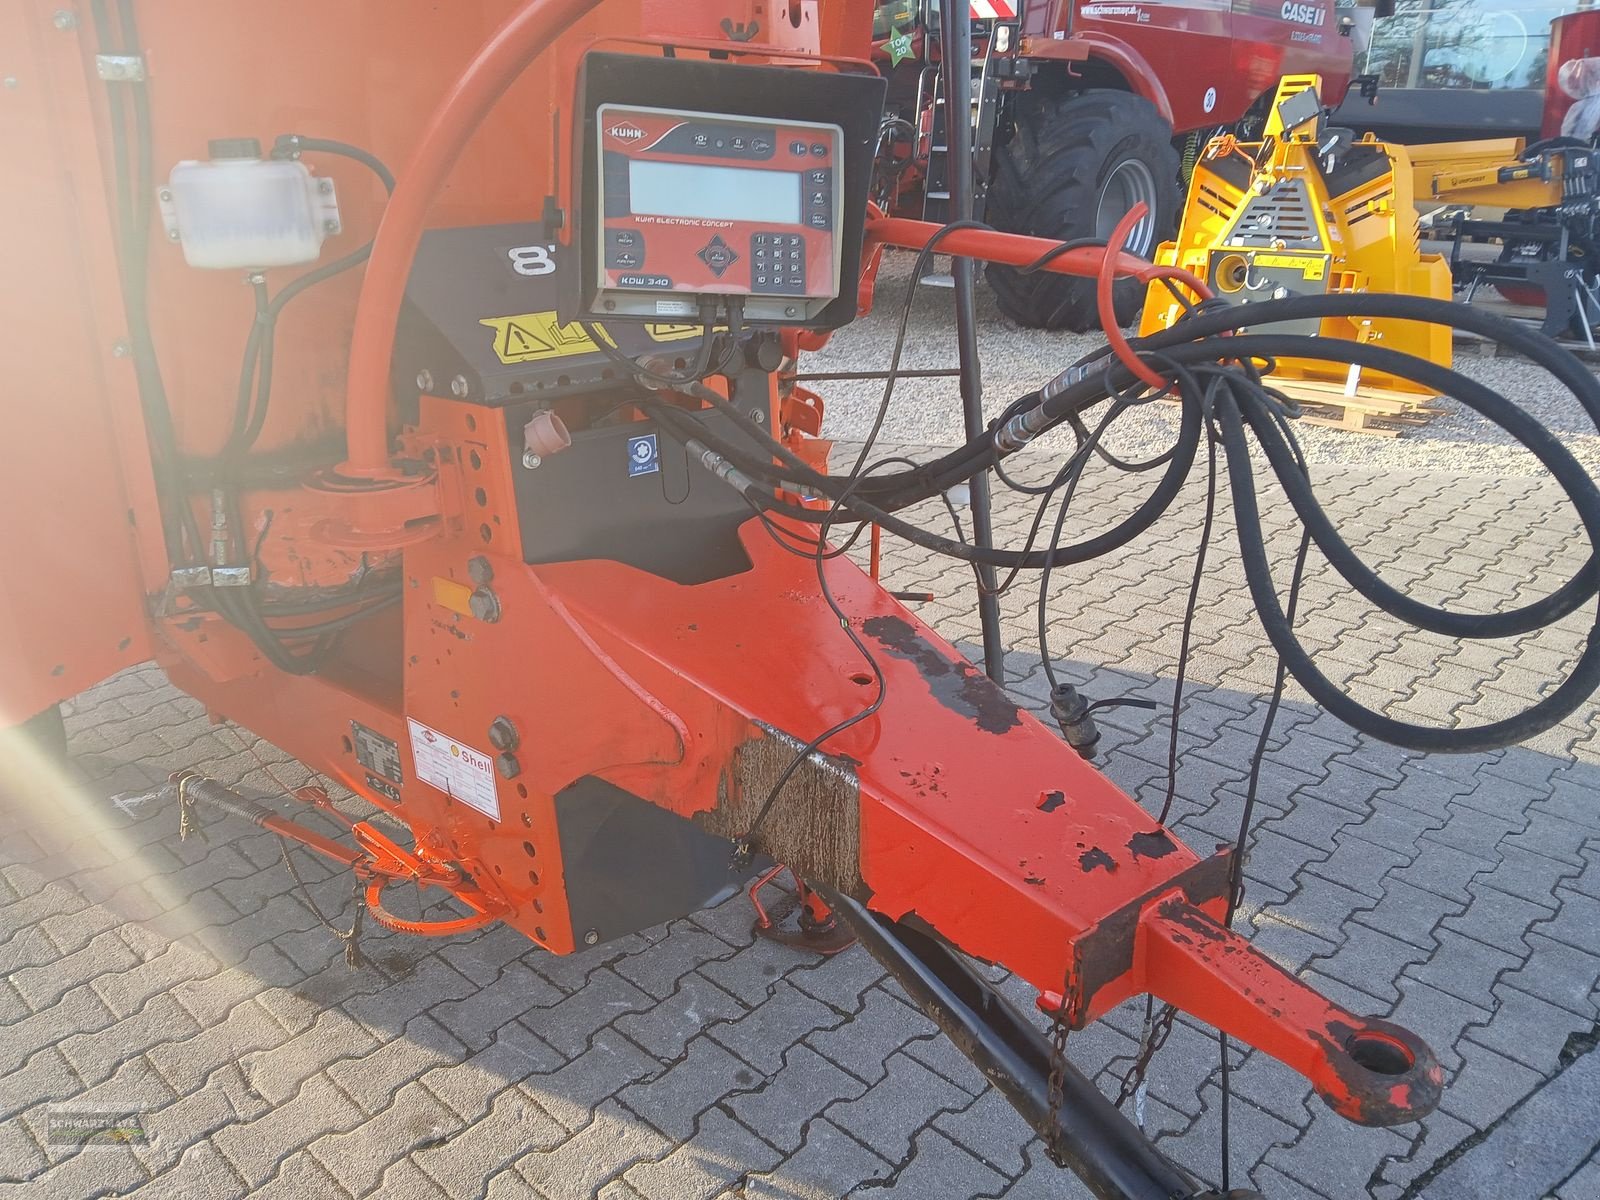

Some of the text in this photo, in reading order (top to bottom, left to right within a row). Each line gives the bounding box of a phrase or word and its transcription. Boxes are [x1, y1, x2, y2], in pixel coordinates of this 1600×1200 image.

[1281, 1, 1315, 24] CASE
[891, 35, 907, 49] TOP
[896, 46, 906, 57] 20
[611, 127, 642, 138] KUHN
[656, 218, 700, 226] ELECTRONIC
[701, 219, 734, 229] CONCEPT
[621, 277, 669, 287] KDW 340
[461, 750, 491, 774] Shell
